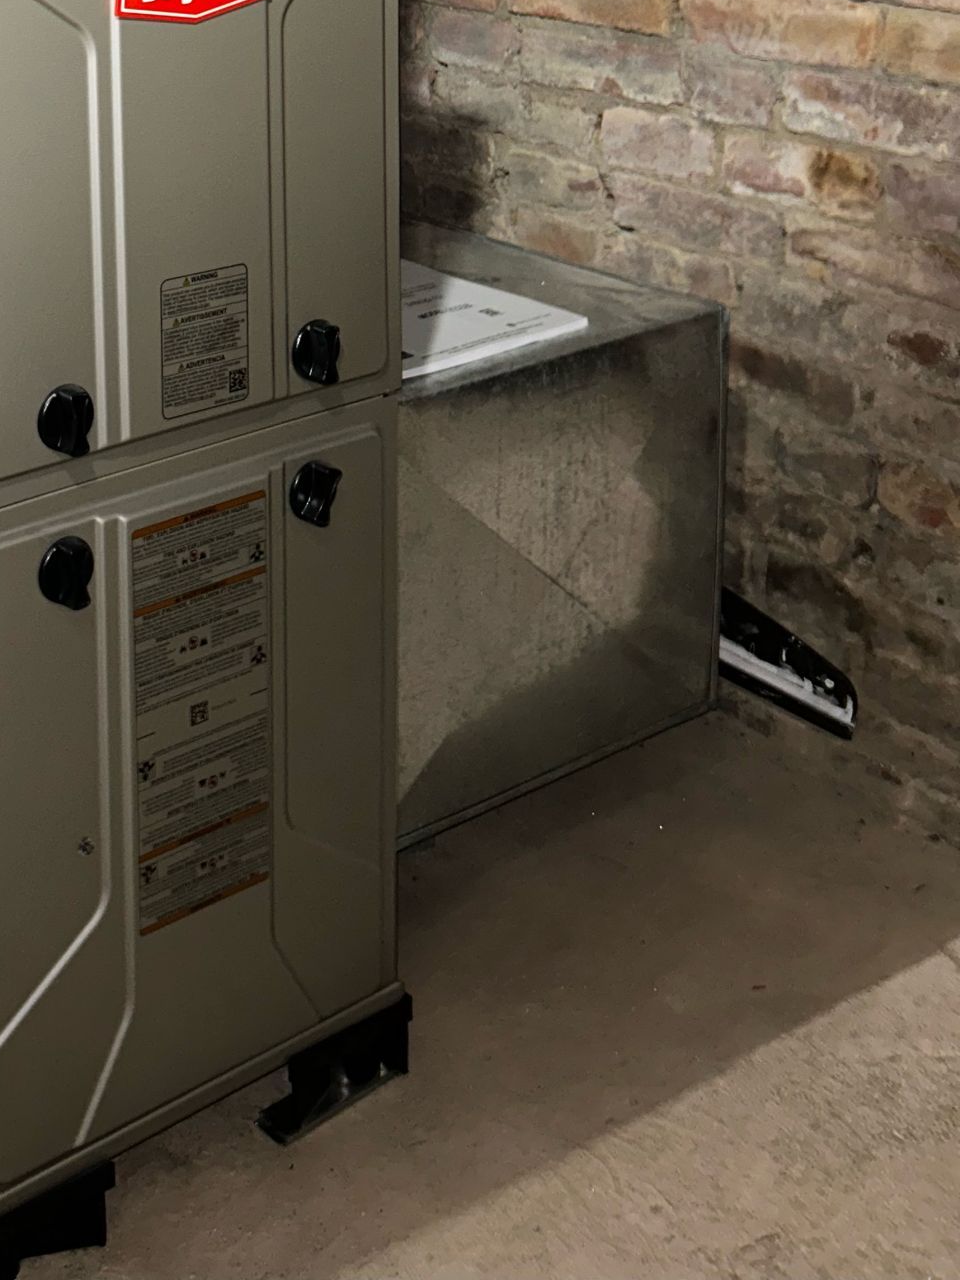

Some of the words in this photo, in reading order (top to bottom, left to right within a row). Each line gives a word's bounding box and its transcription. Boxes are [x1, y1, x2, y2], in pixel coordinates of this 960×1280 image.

[191, 272, 218, 282] WARNING
[180, 308, 227, 323] AVERTISSEMENT
[186, 355, 225, 368] ADVERTENCIA
